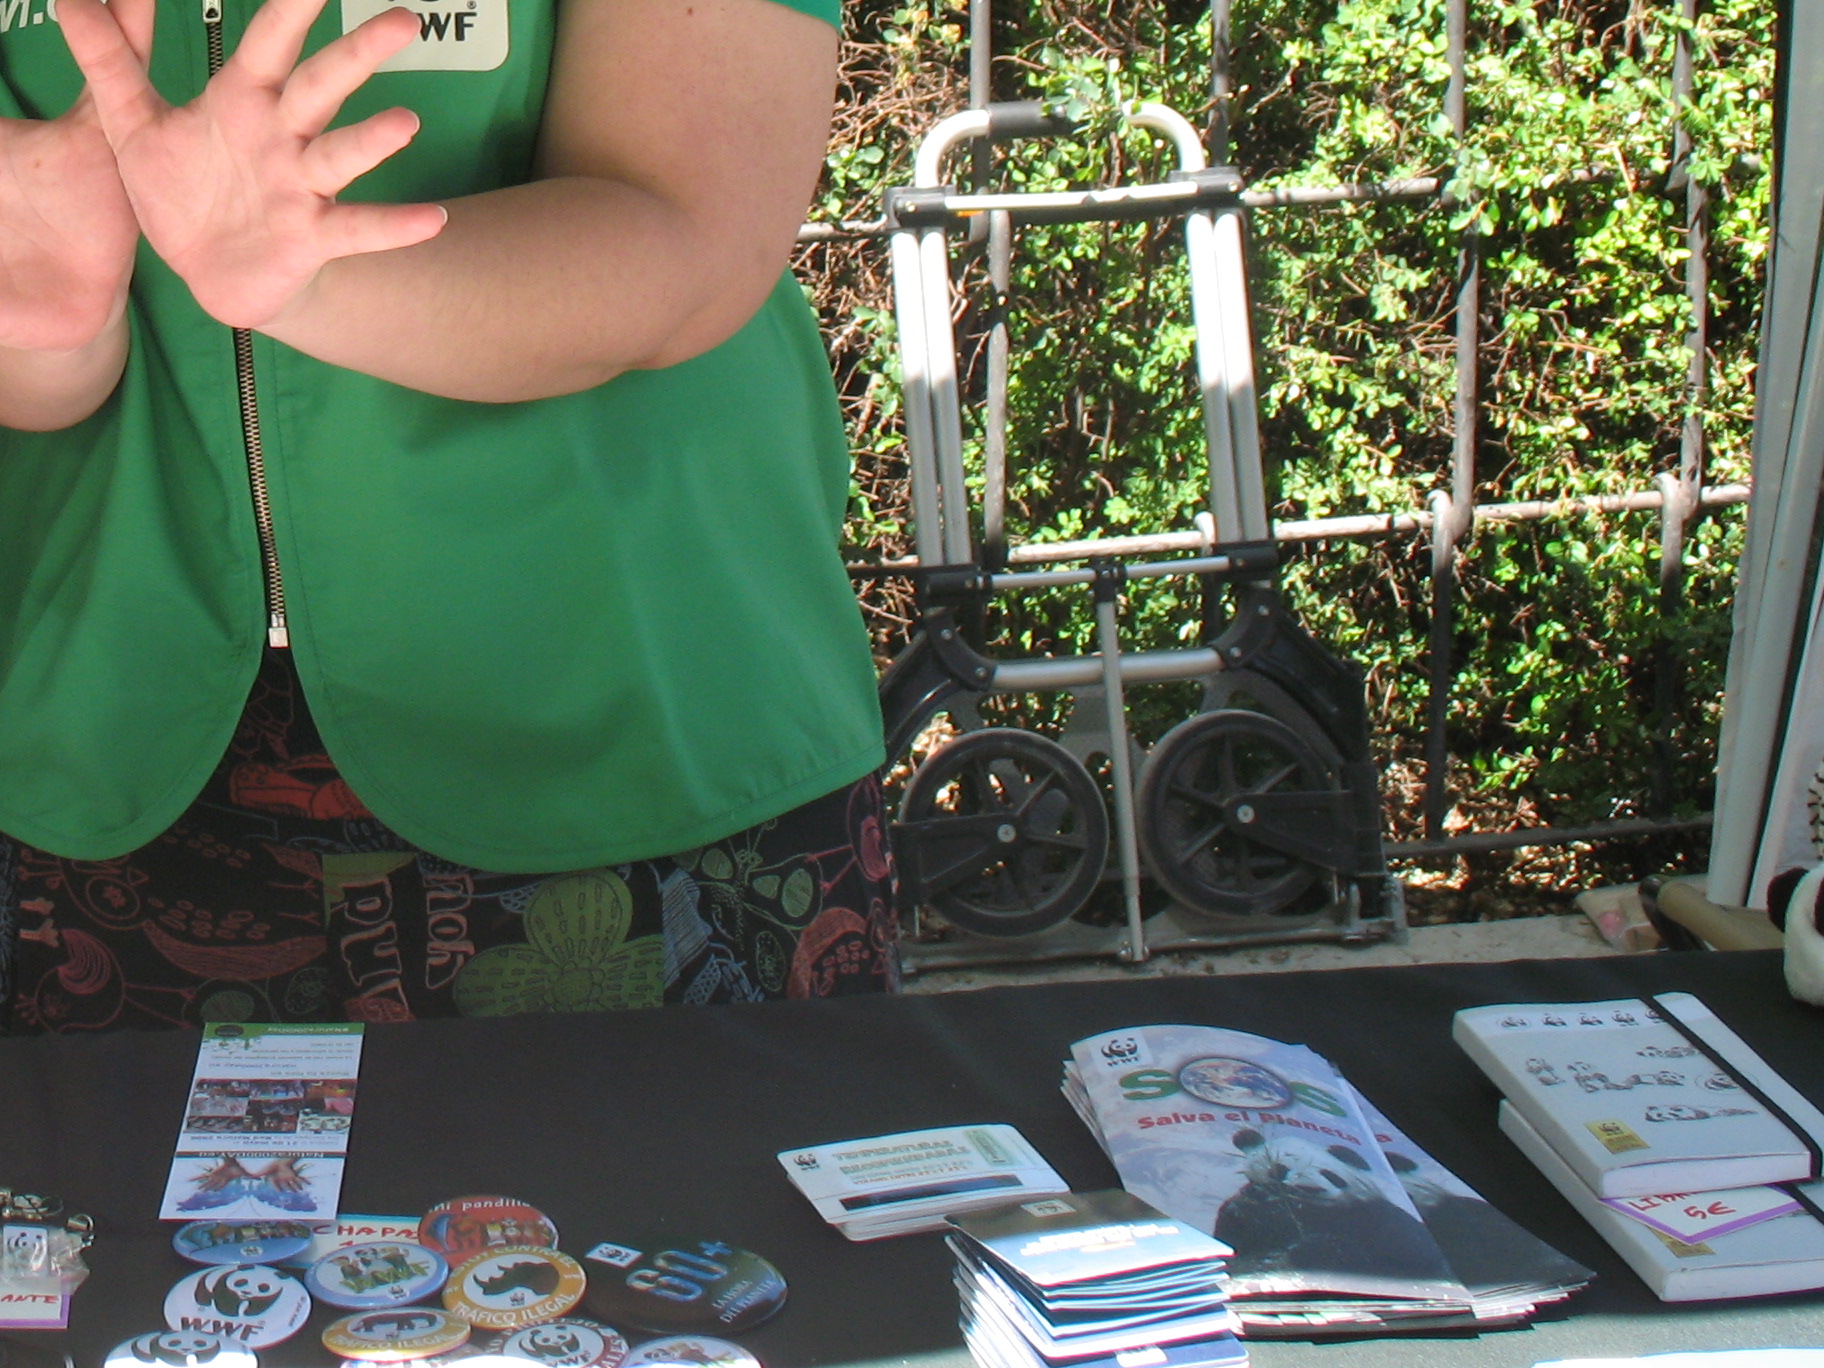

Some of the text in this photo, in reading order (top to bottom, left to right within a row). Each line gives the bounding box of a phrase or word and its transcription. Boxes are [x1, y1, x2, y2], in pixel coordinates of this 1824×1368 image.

[417, 11, 477, 42] WF
[1137, 1112, 1216, 1129] Salva
[1224, 1110, 1251, 1122] el
[1259, 1112, 1362, 1146] Planeta
[180, 1316, 264, 1341] WWF
